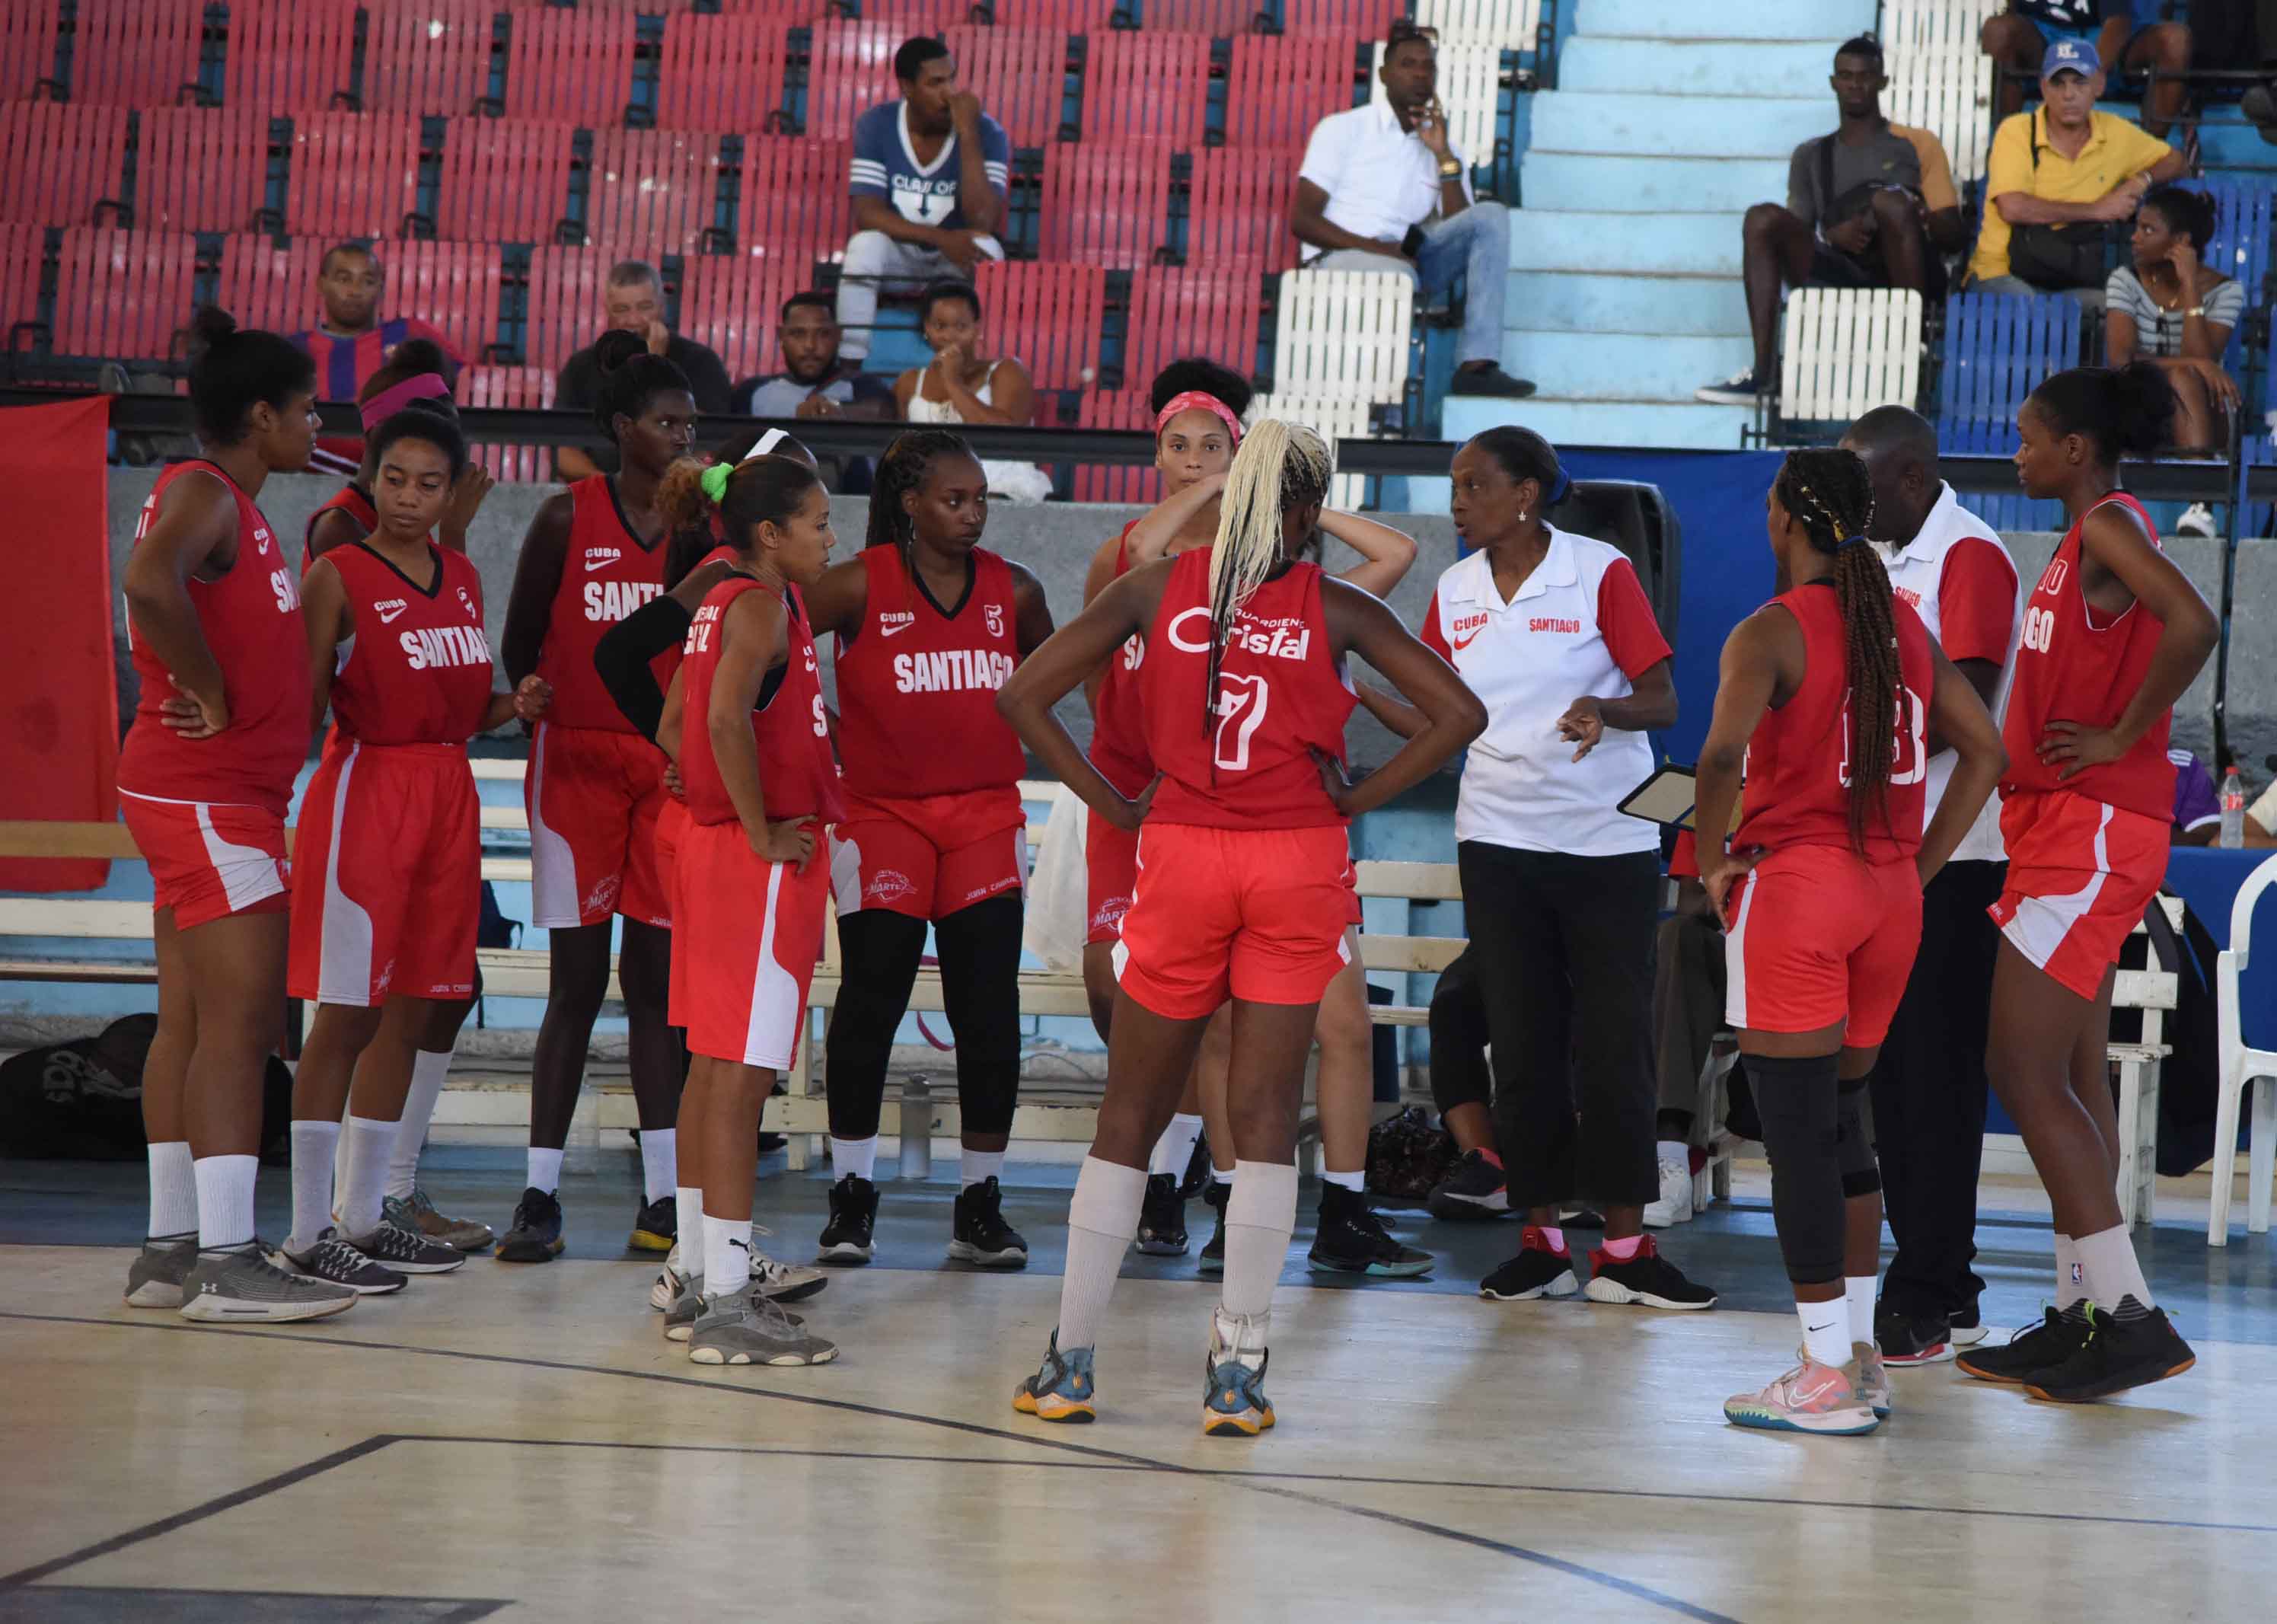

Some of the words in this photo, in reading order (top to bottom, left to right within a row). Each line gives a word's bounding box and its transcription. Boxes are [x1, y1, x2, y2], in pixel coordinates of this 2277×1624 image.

[585, 547, 621, 558] CUBA
[374, 598, 407, 611] CUBA
[880, 611, 915, 622] CUBA
[984, 605, 1004, 637] 5
[1453, 612, 1488, 631] CUBA
[1529, 617, 1580, 633] SANTIAGO
[893, 649, 1014, 694] SANTIAGO
[1212, 671, 1269, 771] 7
